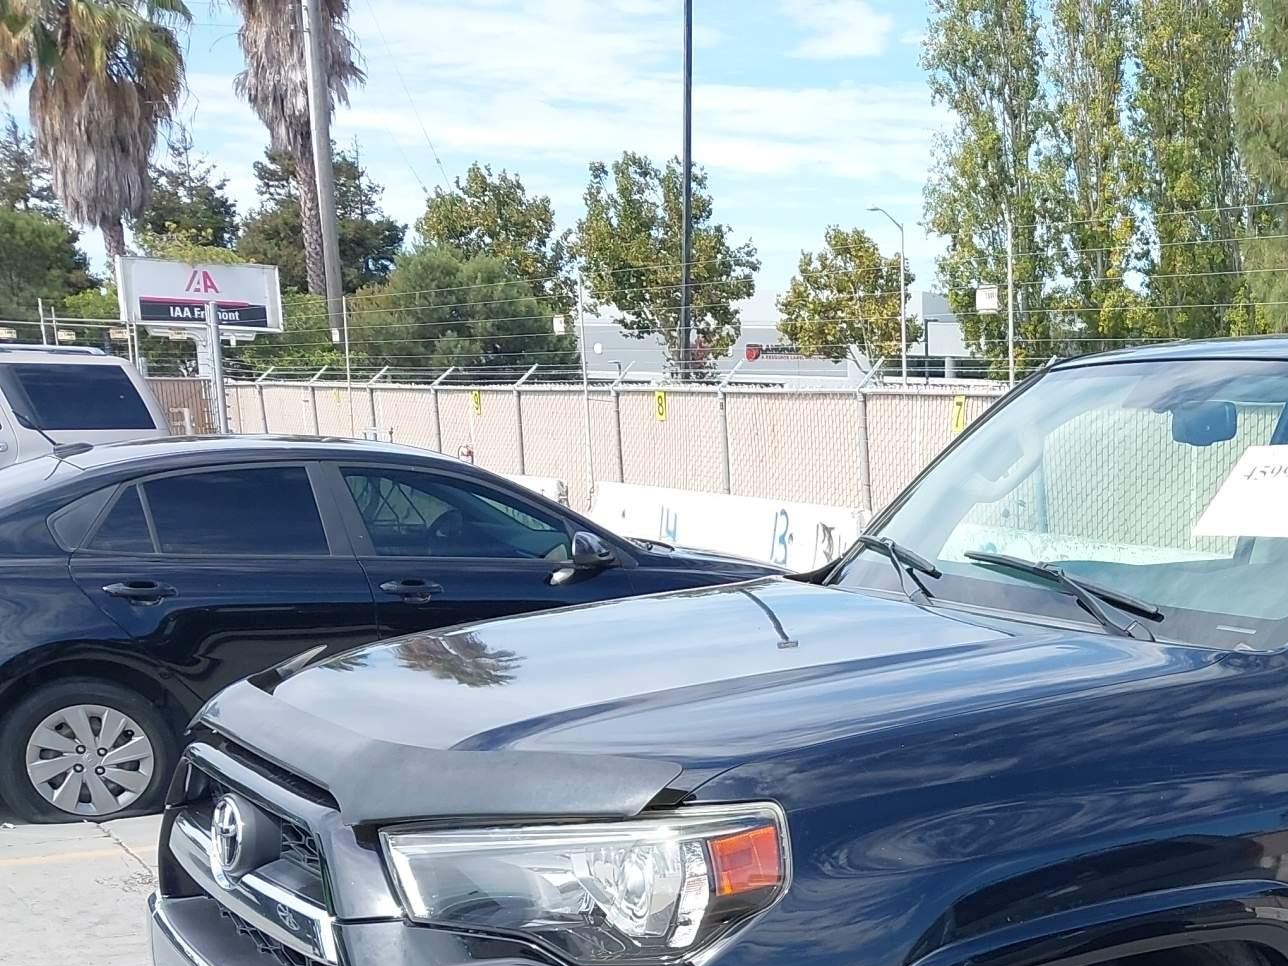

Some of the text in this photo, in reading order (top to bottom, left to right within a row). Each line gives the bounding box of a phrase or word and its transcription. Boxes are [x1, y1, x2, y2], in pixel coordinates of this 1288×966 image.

[169, 305, 240, 321] IAA Front
[473, 392, 480, 411] 9
[657, 395, 664, 416] 8
[955, 401, 963, 429] 7
